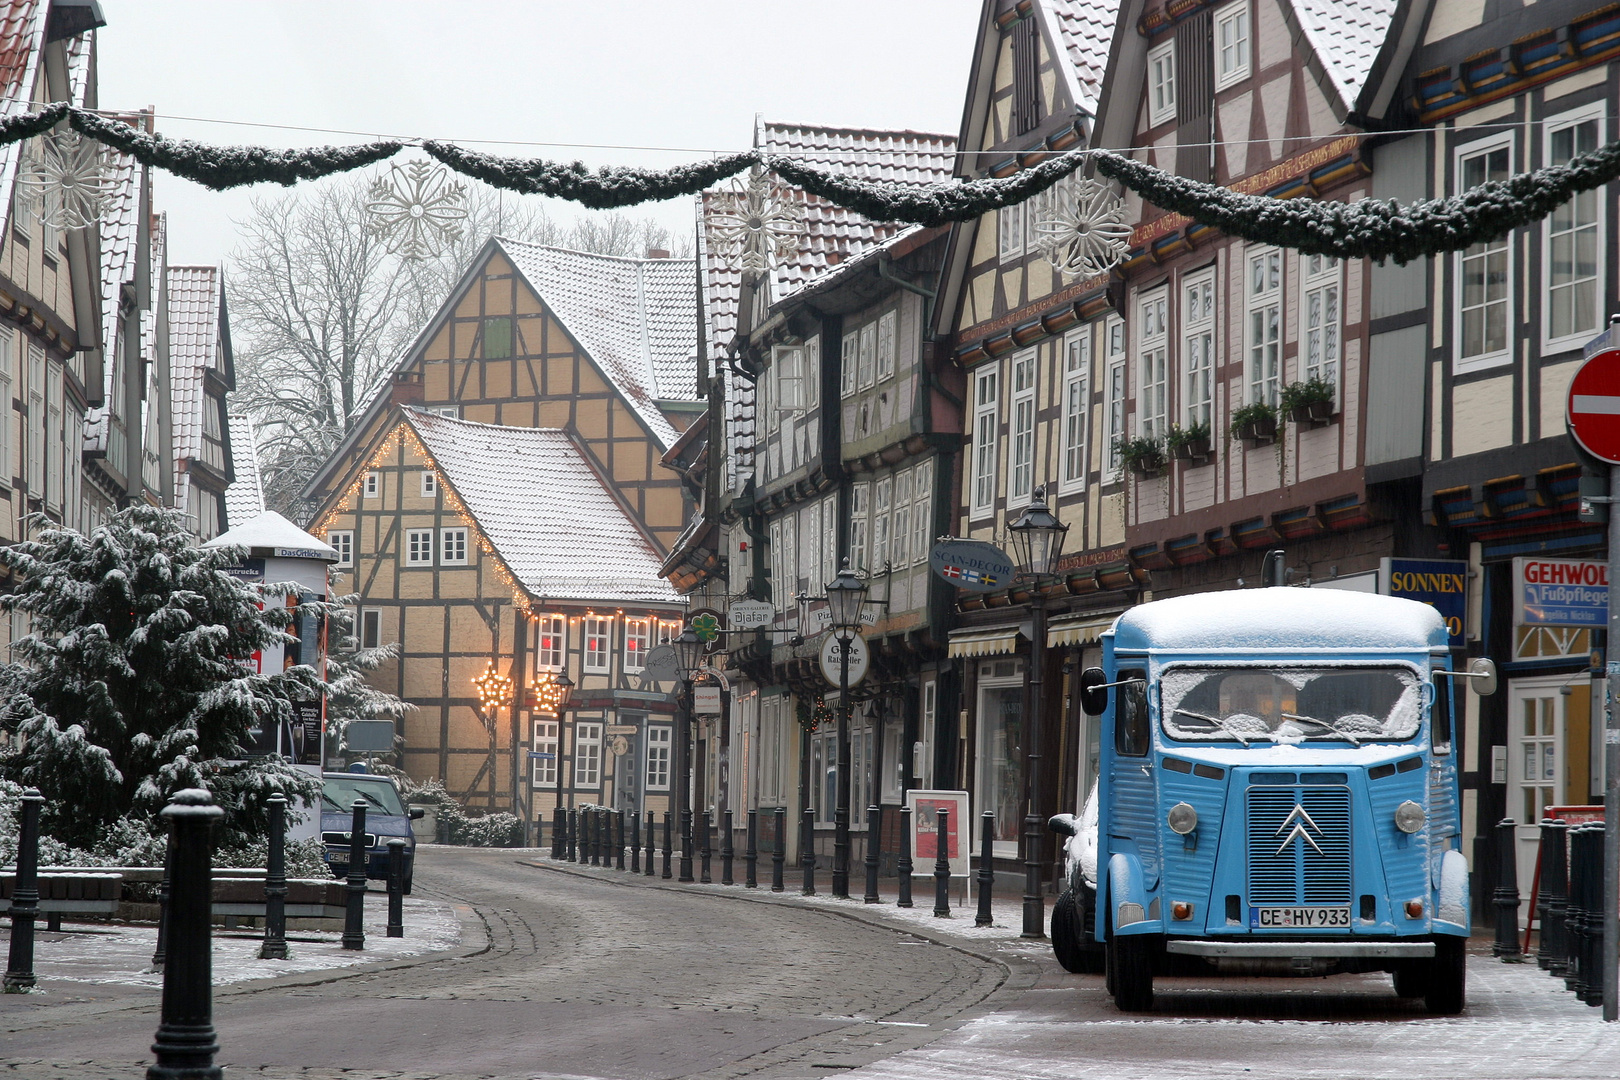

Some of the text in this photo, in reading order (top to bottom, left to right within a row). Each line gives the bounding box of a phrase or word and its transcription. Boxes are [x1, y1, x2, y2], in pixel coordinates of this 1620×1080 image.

[934, 551, 1010, 575] SCAN-DECOR
[1391, 572, 1464, 593] SONNEN
[1524, 562, 1608, 586] GEHWOL
[1541, 586, 1608, 606] Fußpflege
[735, 611, 768, 624] Djafar
[1260, 909, 1282, 925] CE
[1293, 909, 1314, 925] HY
[1318, 909, 1348, 925] 933
